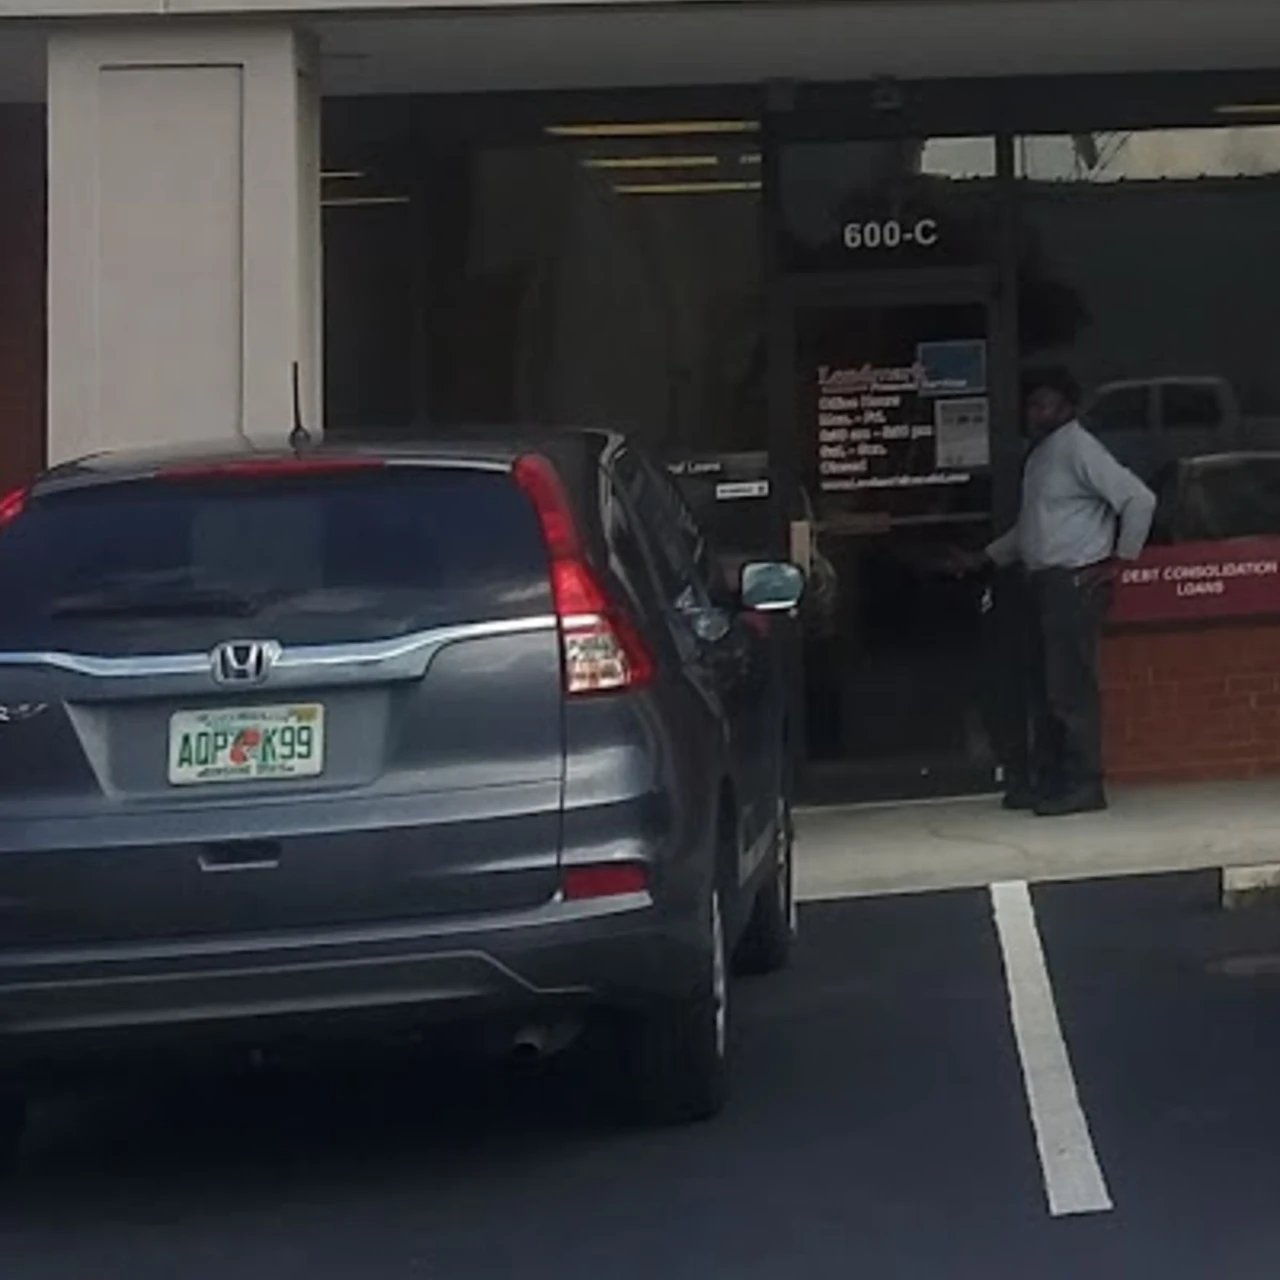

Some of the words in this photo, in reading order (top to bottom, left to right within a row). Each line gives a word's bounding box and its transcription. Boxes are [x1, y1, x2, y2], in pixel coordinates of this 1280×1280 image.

[843, 219, 939, 249] 600-C
[1121, 569, 1160, 583] DEBT
[1163, 561, 1278, 580] CONSOLIDATION
[1176, 581, 1225, 596] LOANS
[262, 726, 312, 762] K99
